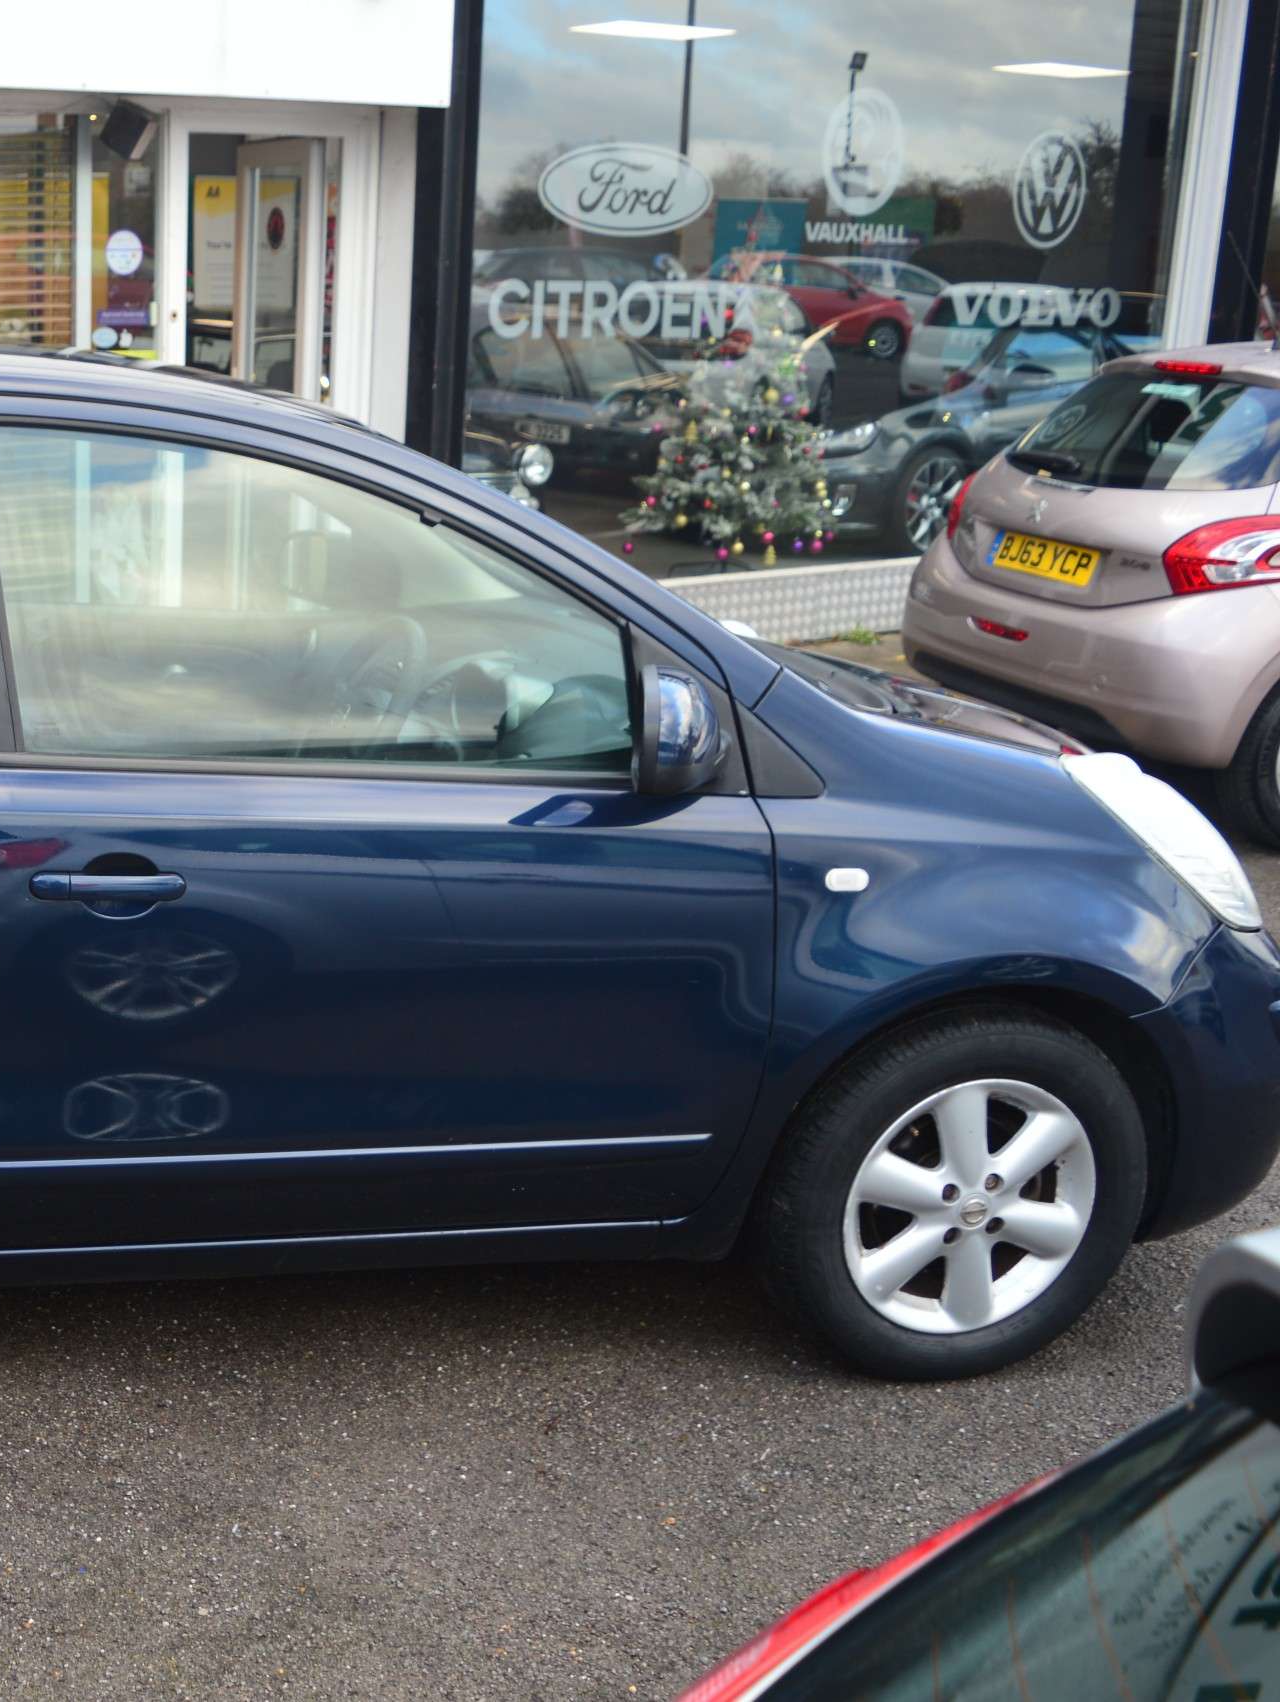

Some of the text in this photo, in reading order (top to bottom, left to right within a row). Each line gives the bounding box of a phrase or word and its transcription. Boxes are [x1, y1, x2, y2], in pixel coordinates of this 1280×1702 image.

[578, 158, 676, 216] Ford
[805, 221, 909, 243] VAUXHALL
[949, 286, 1122, 328] VOLVO
[998, 534, 1049, 567] BJ63
[1049, 545, 1093, 577] YCP
